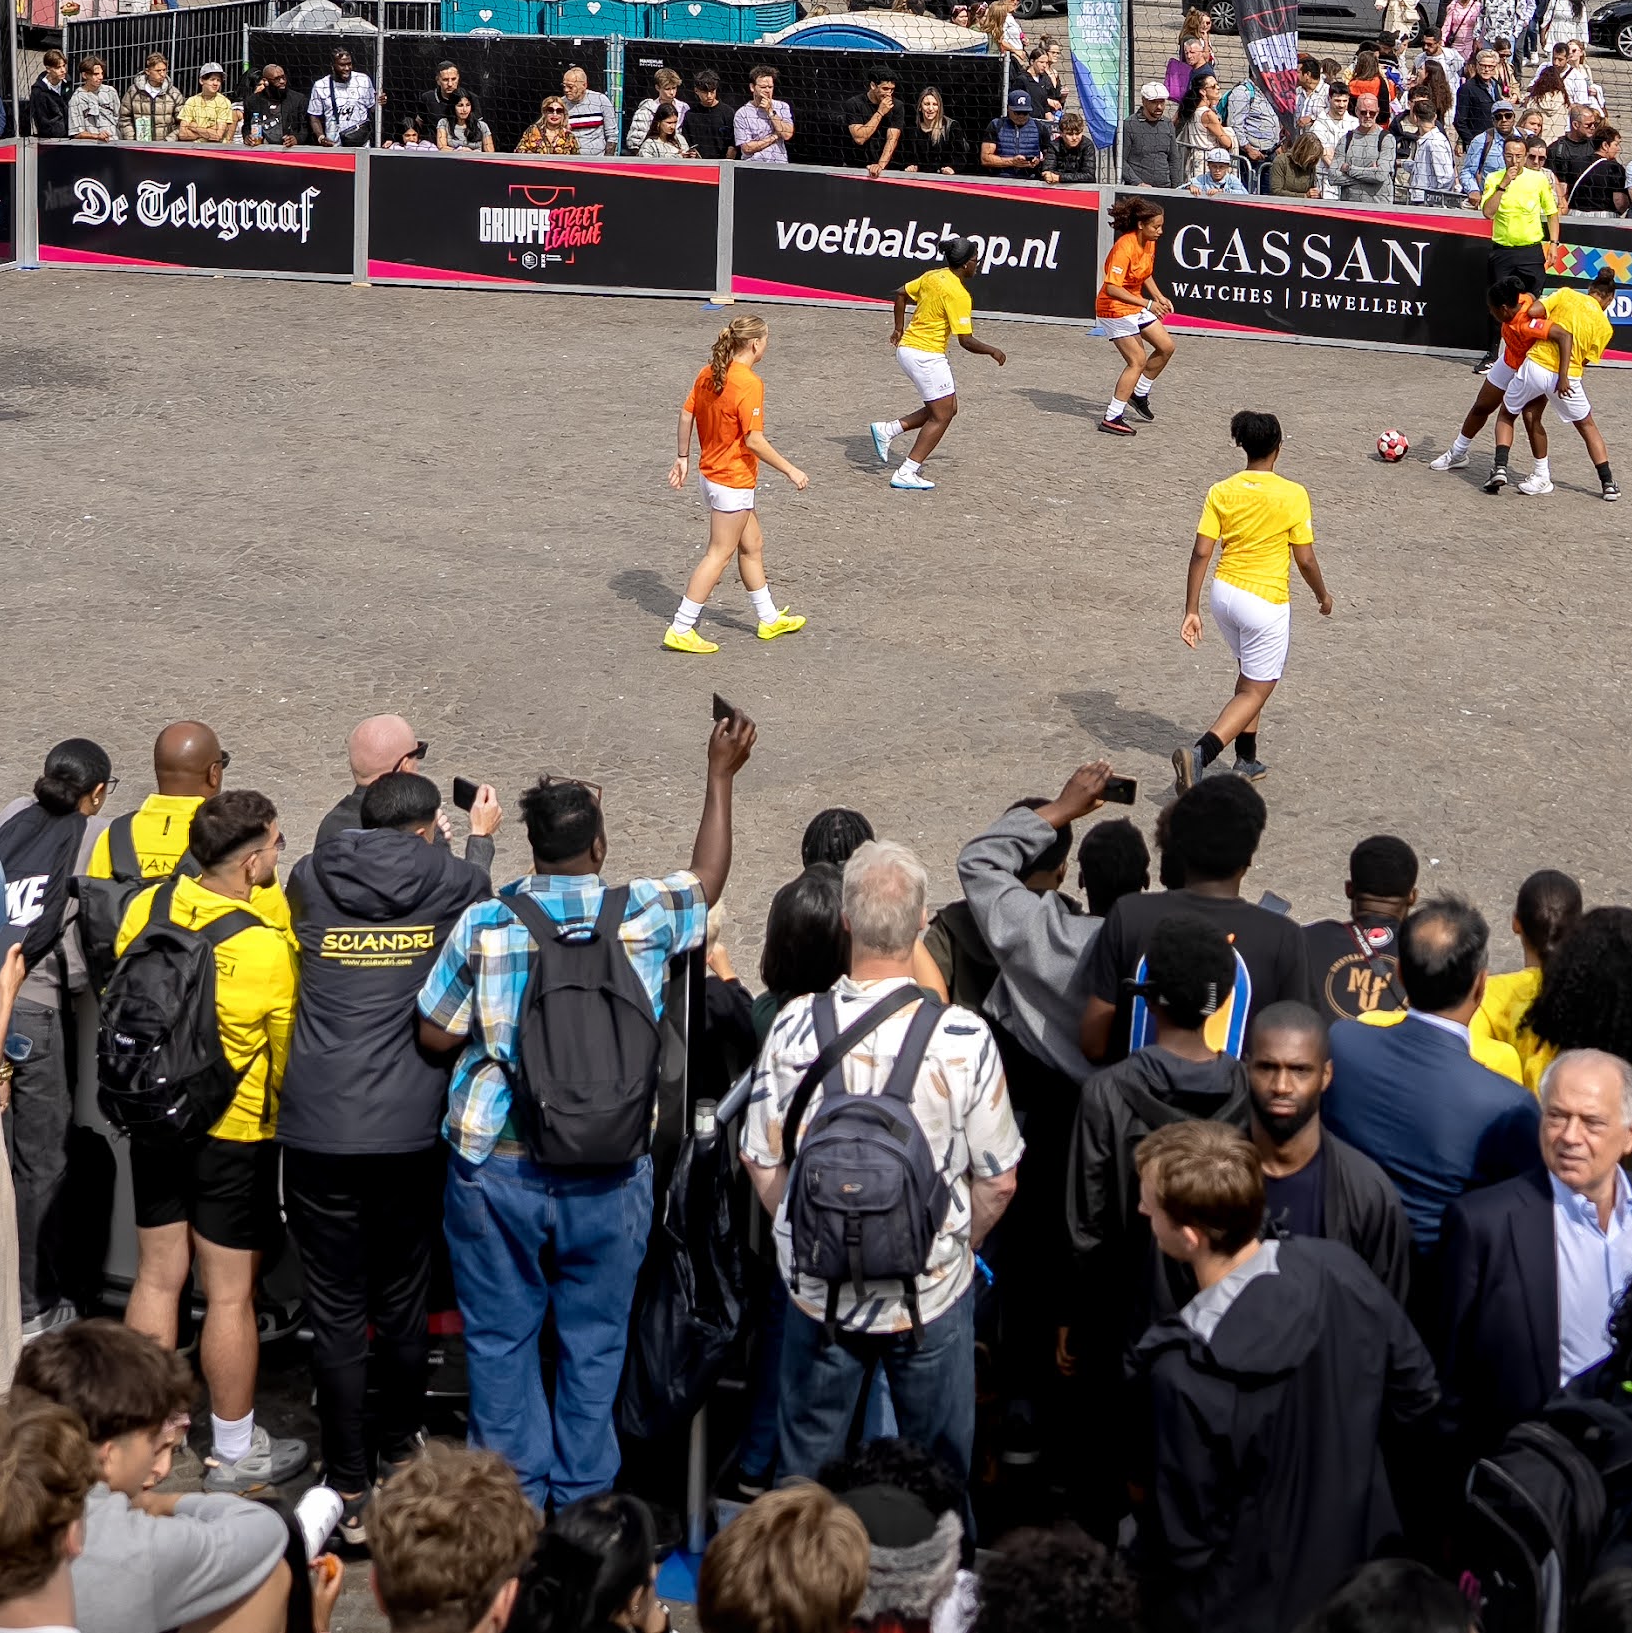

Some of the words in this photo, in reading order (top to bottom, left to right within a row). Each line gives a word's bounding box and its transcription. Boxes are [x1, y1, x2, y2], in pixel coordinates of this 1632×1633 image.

[73, 177, 129, 227] De
[137, 179, 322, 244] Telegraaf
[479, 206, 551, 245] CRUYFF
[548, 204, 604, 232] STREET
[544, 224, 604, 251] LEAGUE
[1172, 223, 1431, 287] GASSAN
[1171, 281, 1274, 306] WATCHES
[1301, 292, 1429, 318] JEWELLERY
[5, 873, 51, 922] KE
[319, 931, 436, 953] SCIANDRI
[338, 956, 415, 968] www.sciandri.com
